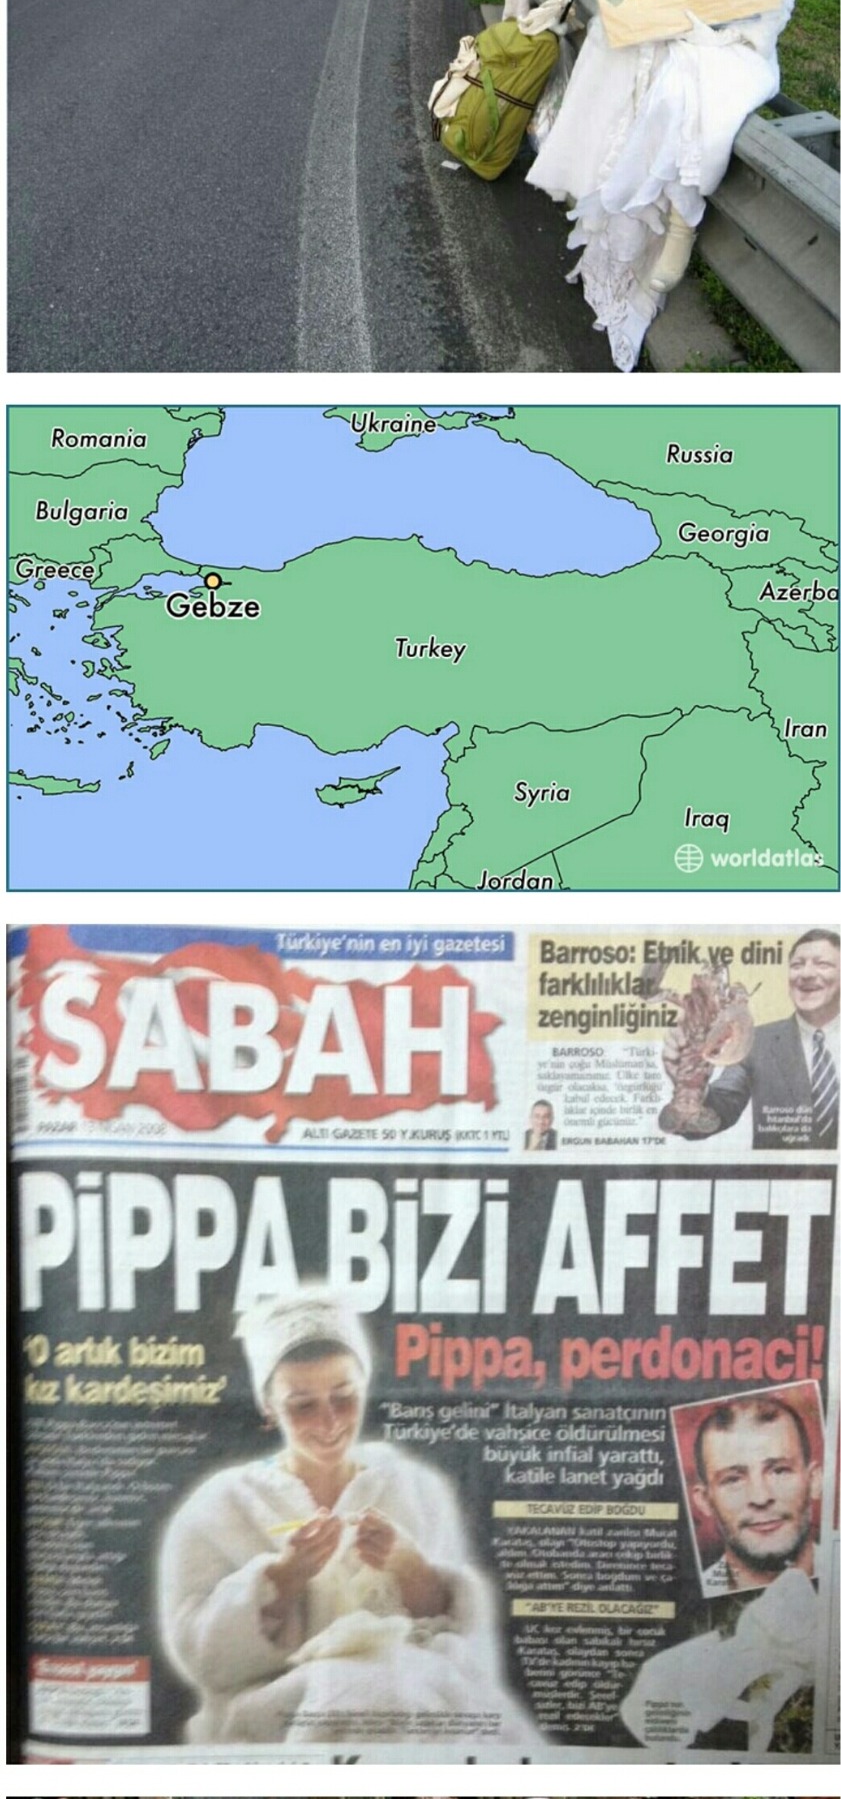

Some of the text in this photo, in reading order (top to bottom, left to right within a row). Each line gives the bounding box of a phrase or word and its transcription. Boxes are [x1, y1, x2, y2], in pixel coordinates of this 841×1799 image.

[351, 413, 437, 434] Ukraine
[51, 428, 148, 449] Romania
[665, 443, 734, 464] Russia
[35, 499, 129, 526] Bulgaria
[678, 522, 770, 548] Georgia
[15, 558, 95, 579] Greece
[759, 580, 839, 601] Azerba
[166, 592, 260, 619] Gebze
[395, 635, 467, 663] Turkey
[784, 718, 827, 738] Iran
[514, 781, 570, 807] Syria
[684, 808, 730, 833] Iraq
[476, 870, 553, 890] Jordan
[379, 939, 402, 952] en
[406, 935, 429, 956] iyi
[433, 935, 505, 957] gazetesi
[540, 940, 783, 964] Barroso: Etnik ve dini
[39, 972, 469, 1096] SABAH
[532, 1179, 832, 1316] AFFET
[394, 1321, 826, 1393] Pippa, perdonaci!
[483, 1446, 542, 1467] büyük
